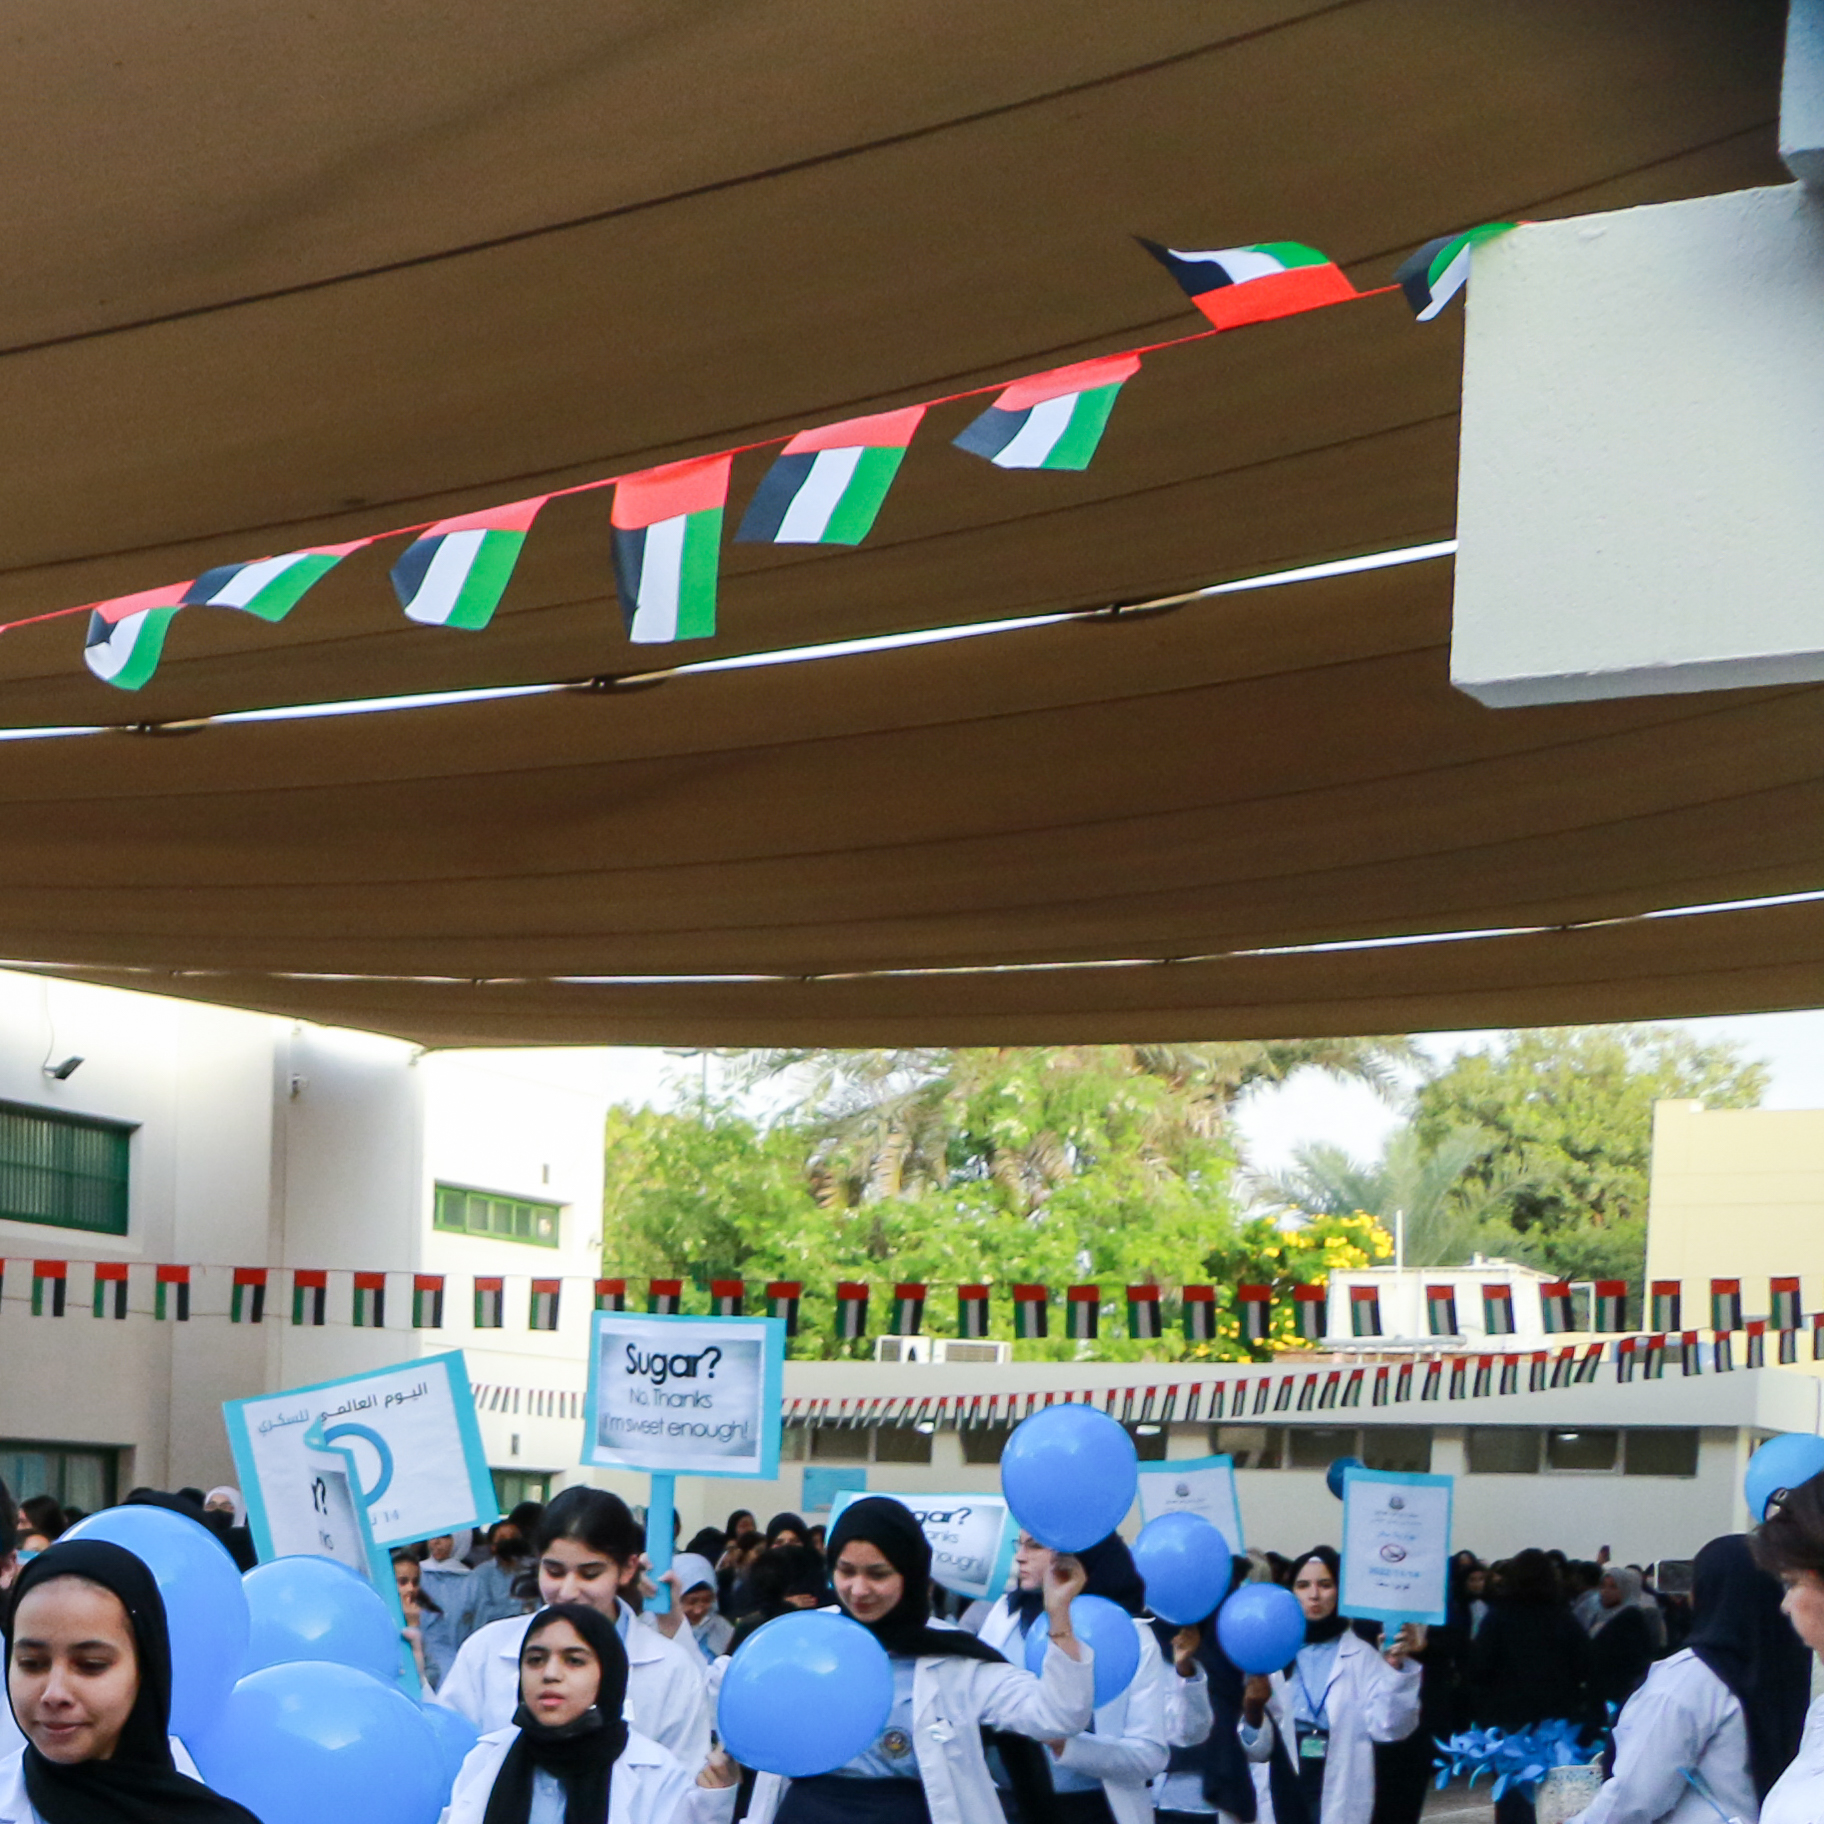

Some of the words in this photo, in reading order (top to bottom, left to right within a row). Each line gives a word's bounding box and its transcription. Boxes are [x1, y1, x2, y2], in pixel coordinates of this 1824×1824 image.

[625, 1342, 722, 1385] Sugar?
[384, 1381, 428, 1409] اليوم
[654, 1387, 713, 1409] Thanks
[320, 1394, 378, 1424] العالمي
[257, 1408, 309, 1437] للسكري
[667, 1419, 749, 1443] enough!
[913, 1507, 972, 1526] gar?
[925, 1530, 959, 1544] anks
